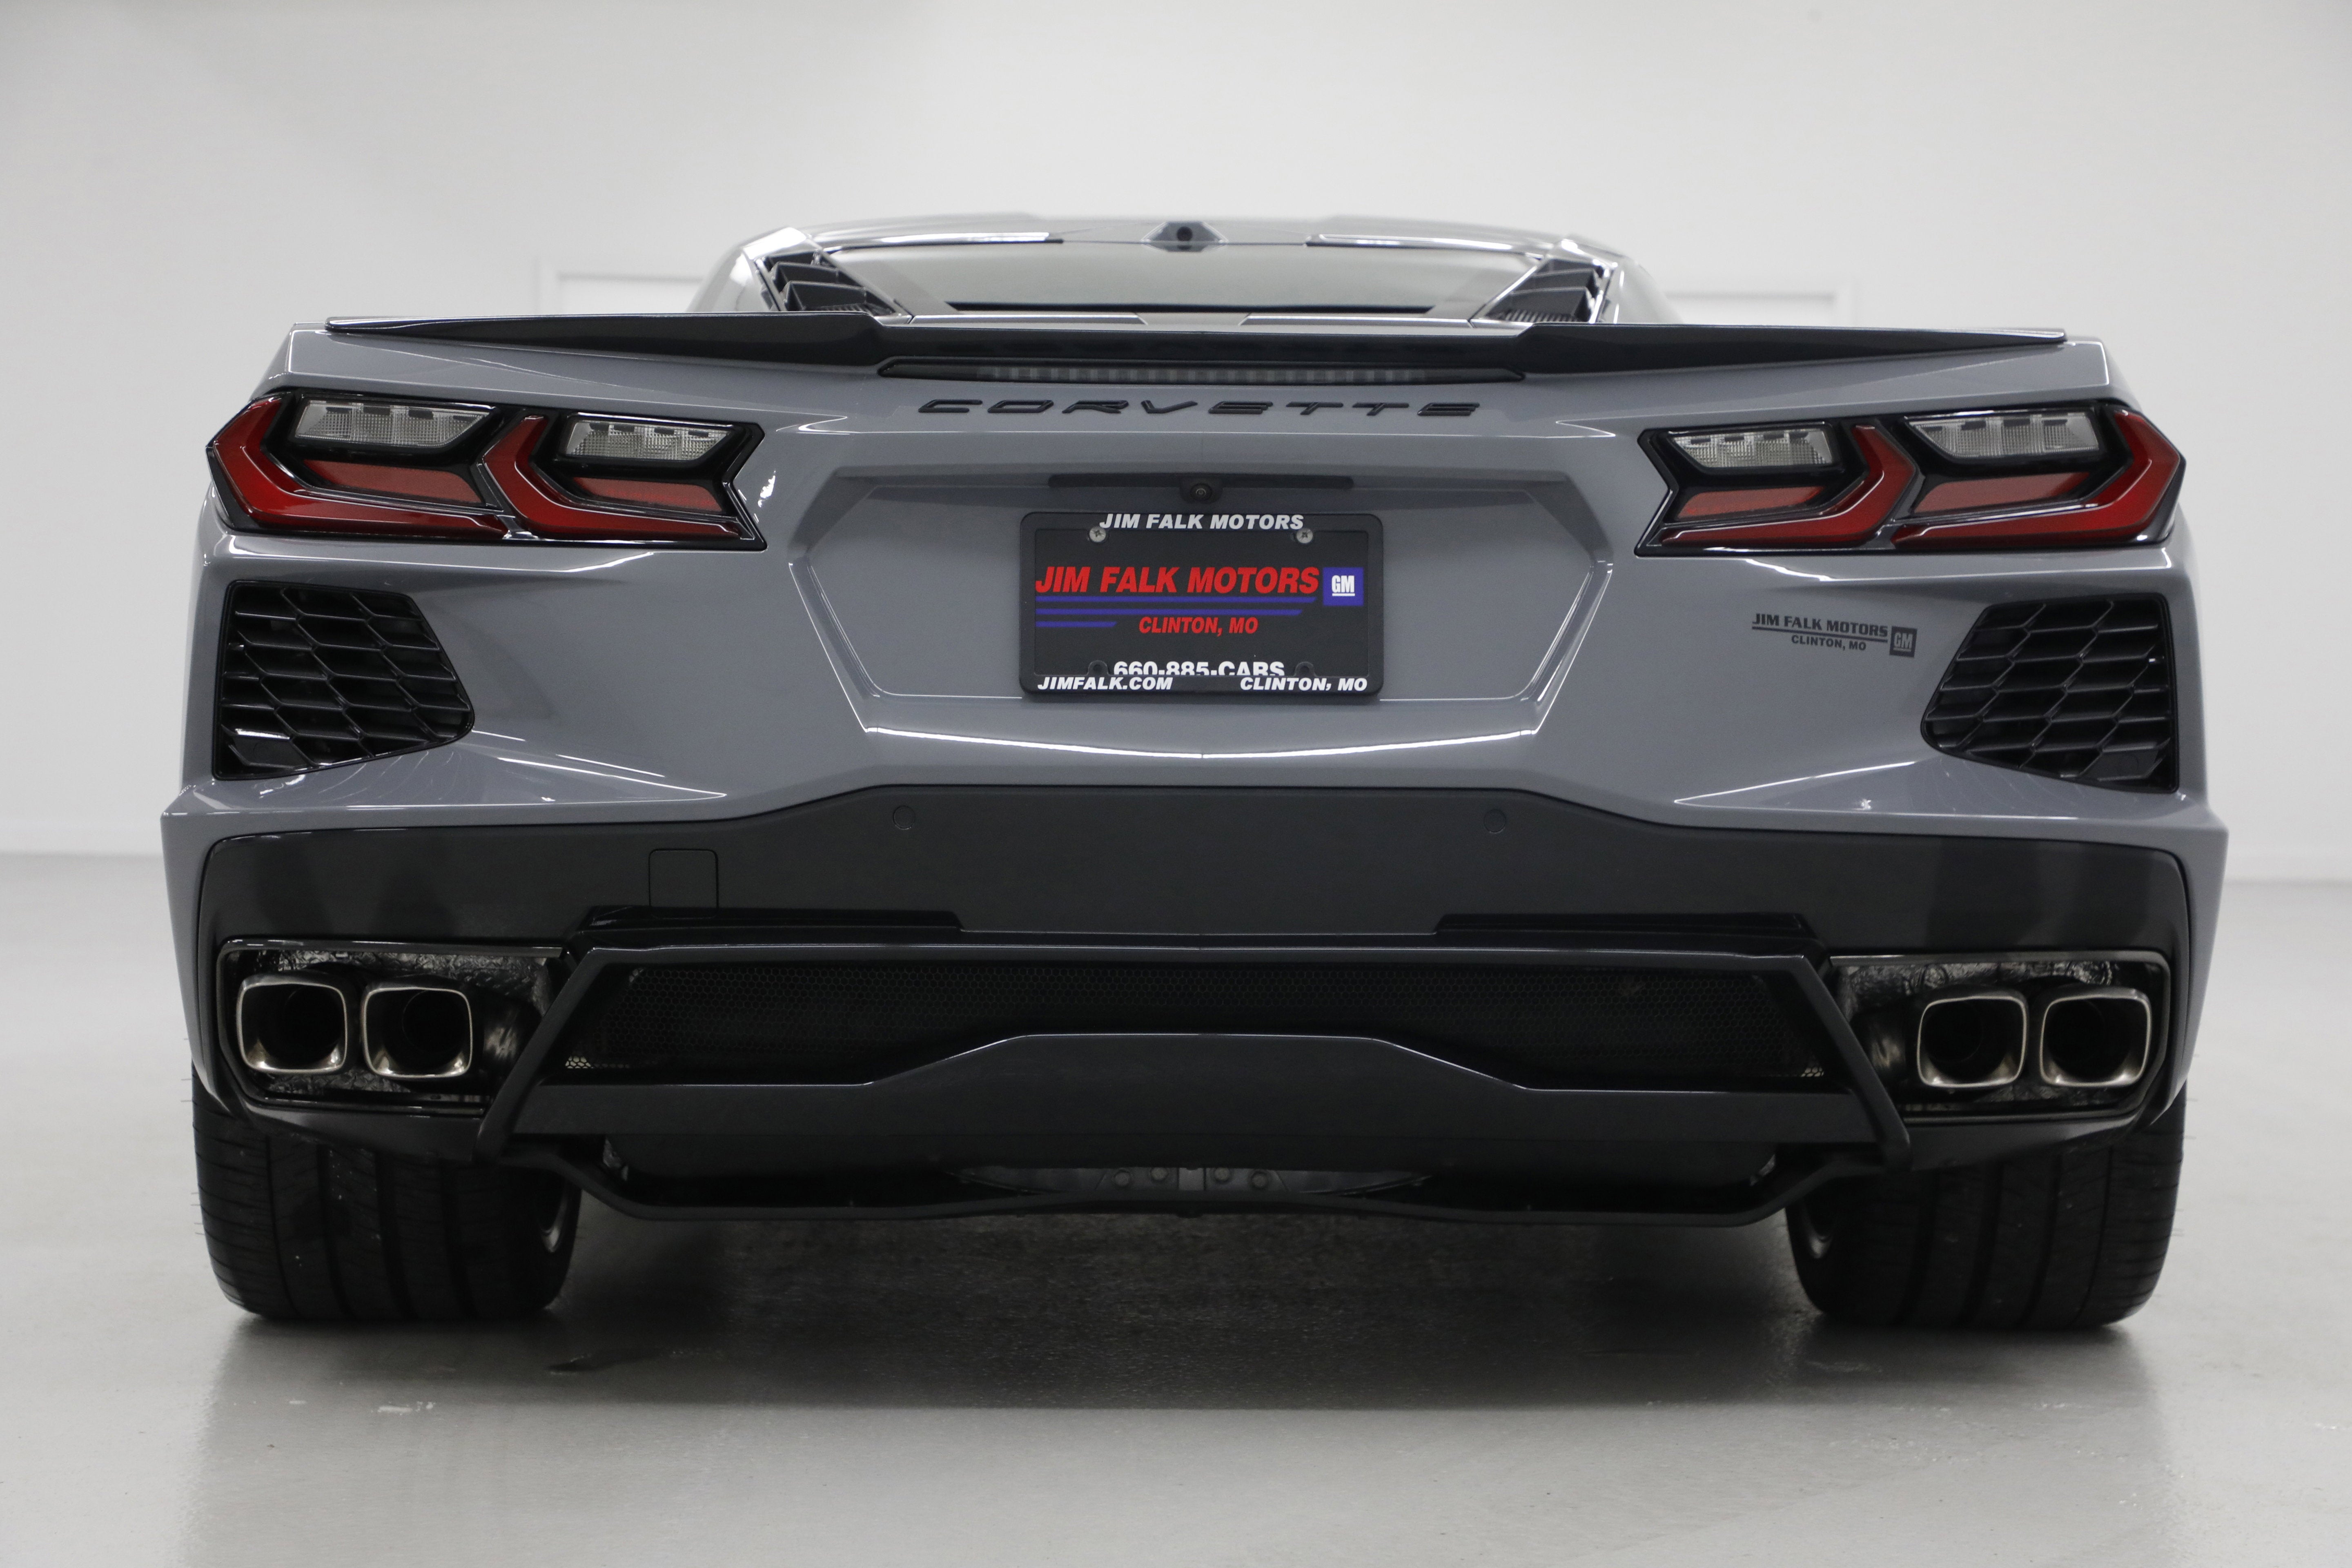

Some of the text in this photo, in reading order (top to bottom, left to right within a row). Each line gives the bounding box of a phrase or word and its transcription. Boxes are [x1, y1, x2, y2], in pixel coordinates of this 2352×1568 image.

[918, 399, 1481, 416] CORVETTE
[1099, 513, 1304, 530] JIM FALK MOTORS
[1035, 566, 1320, 594] JIM FALK MOTORS
[1331, 575, 1355, 593] GM
[1138, 617, 1259, 637] CLINTON, MO
[1752, 613, 1888, 637] JIM FALK MOTORS
[1791, 635, 1867, 651] CLINTON, MO
[1893, 632, 1913, 650] GM
[1037, 677, 1173, 690] JIMFALK.COM
[1240, 677, 1368, 691] CLINTON, MO
